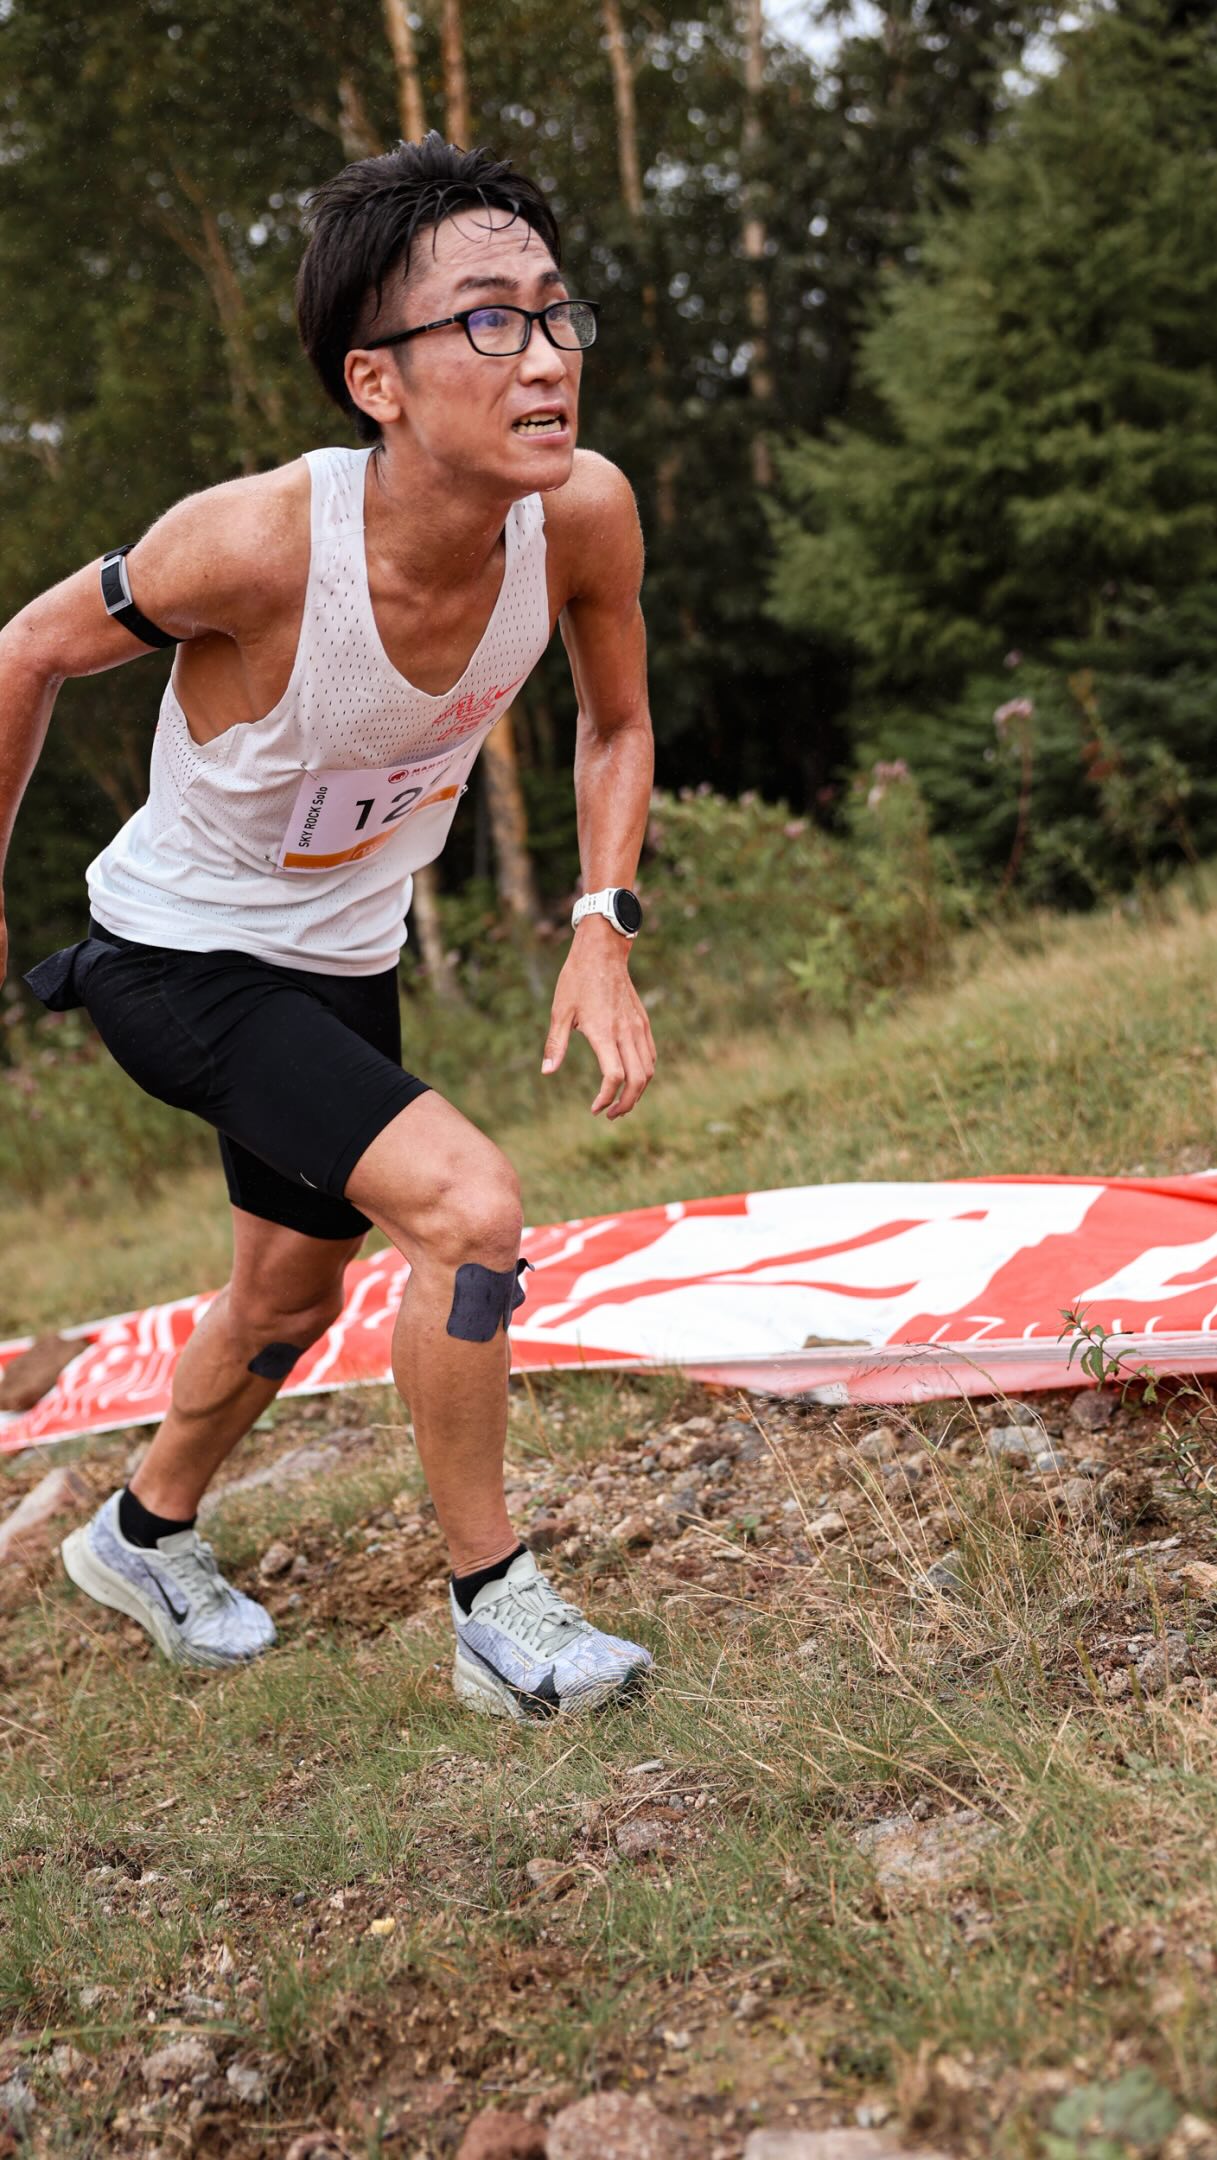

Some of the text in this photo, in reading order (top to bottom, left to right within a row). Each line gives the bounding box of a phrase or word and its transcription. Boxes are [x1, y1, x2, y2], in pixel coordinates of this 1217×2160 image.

[298, 786, 328, 848] SKY ROCK Solo
